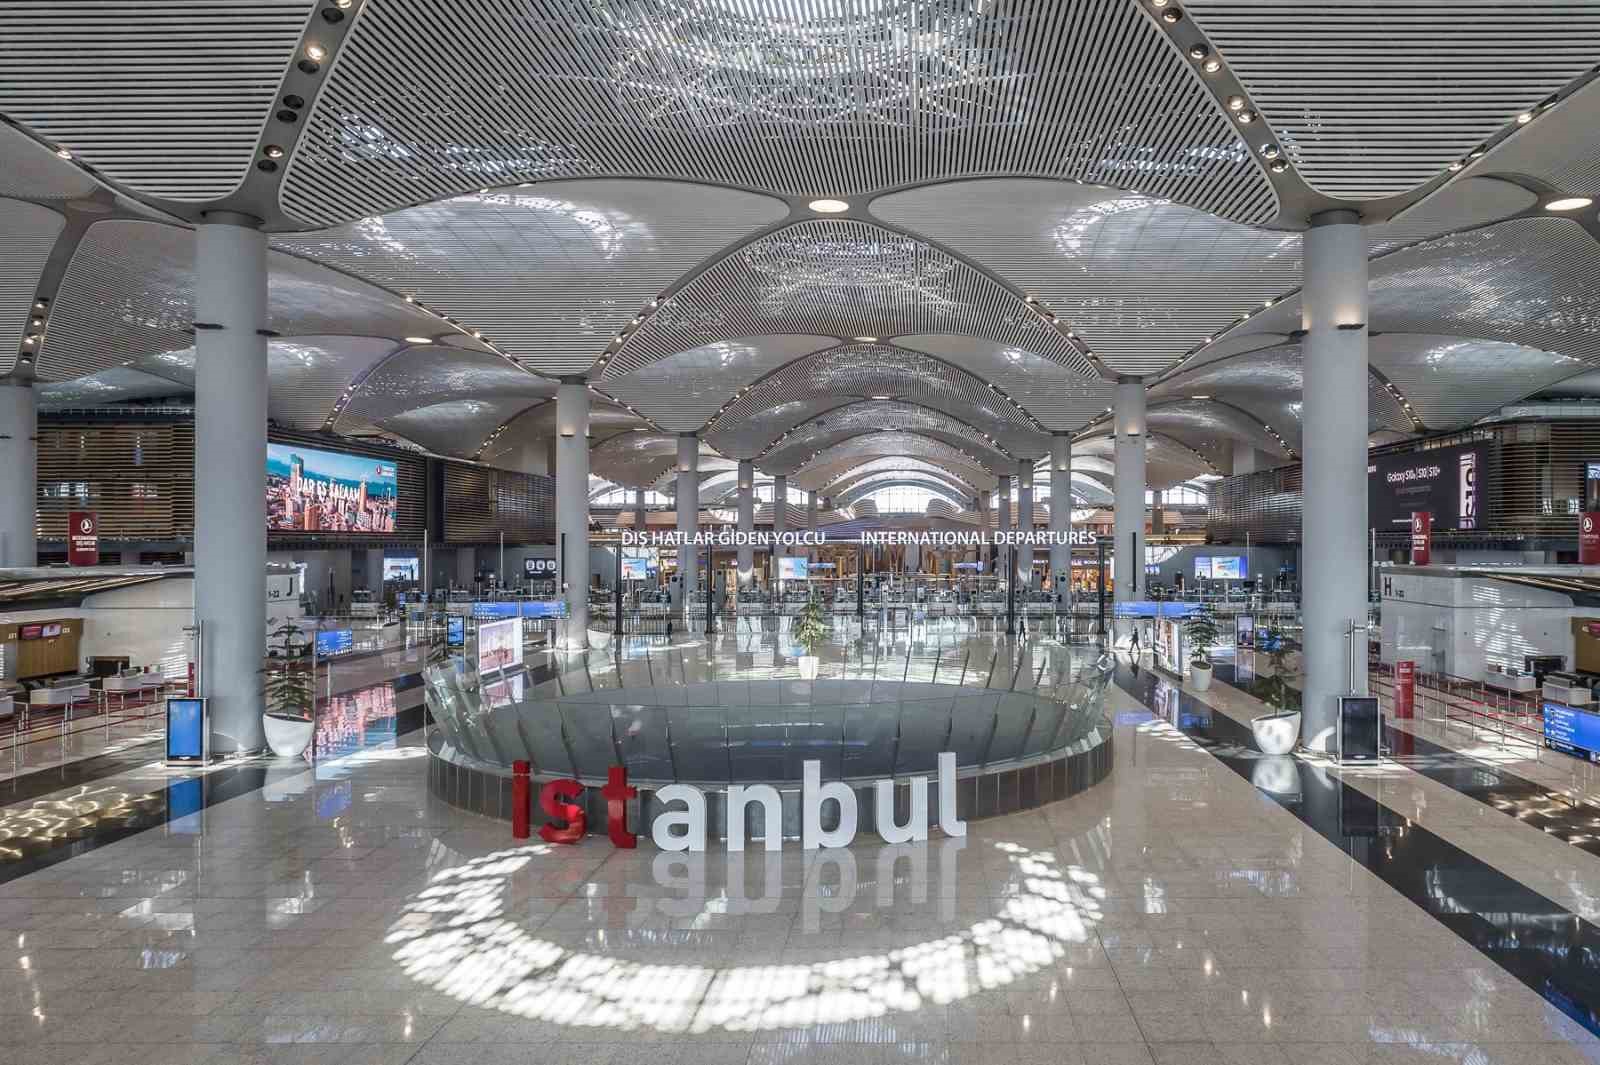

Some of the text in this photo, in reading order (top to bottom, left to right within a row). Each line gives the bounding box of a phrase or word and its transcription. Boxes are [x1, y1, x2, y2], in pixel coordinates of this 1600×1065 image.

[621, 528, 826, 549] DIŞ HATLAR GİDEN YOLCU
[861, 531, 1097, 545] INTERNATIONAL DEPARTURES
[1384, 576, 1392, 597] H
